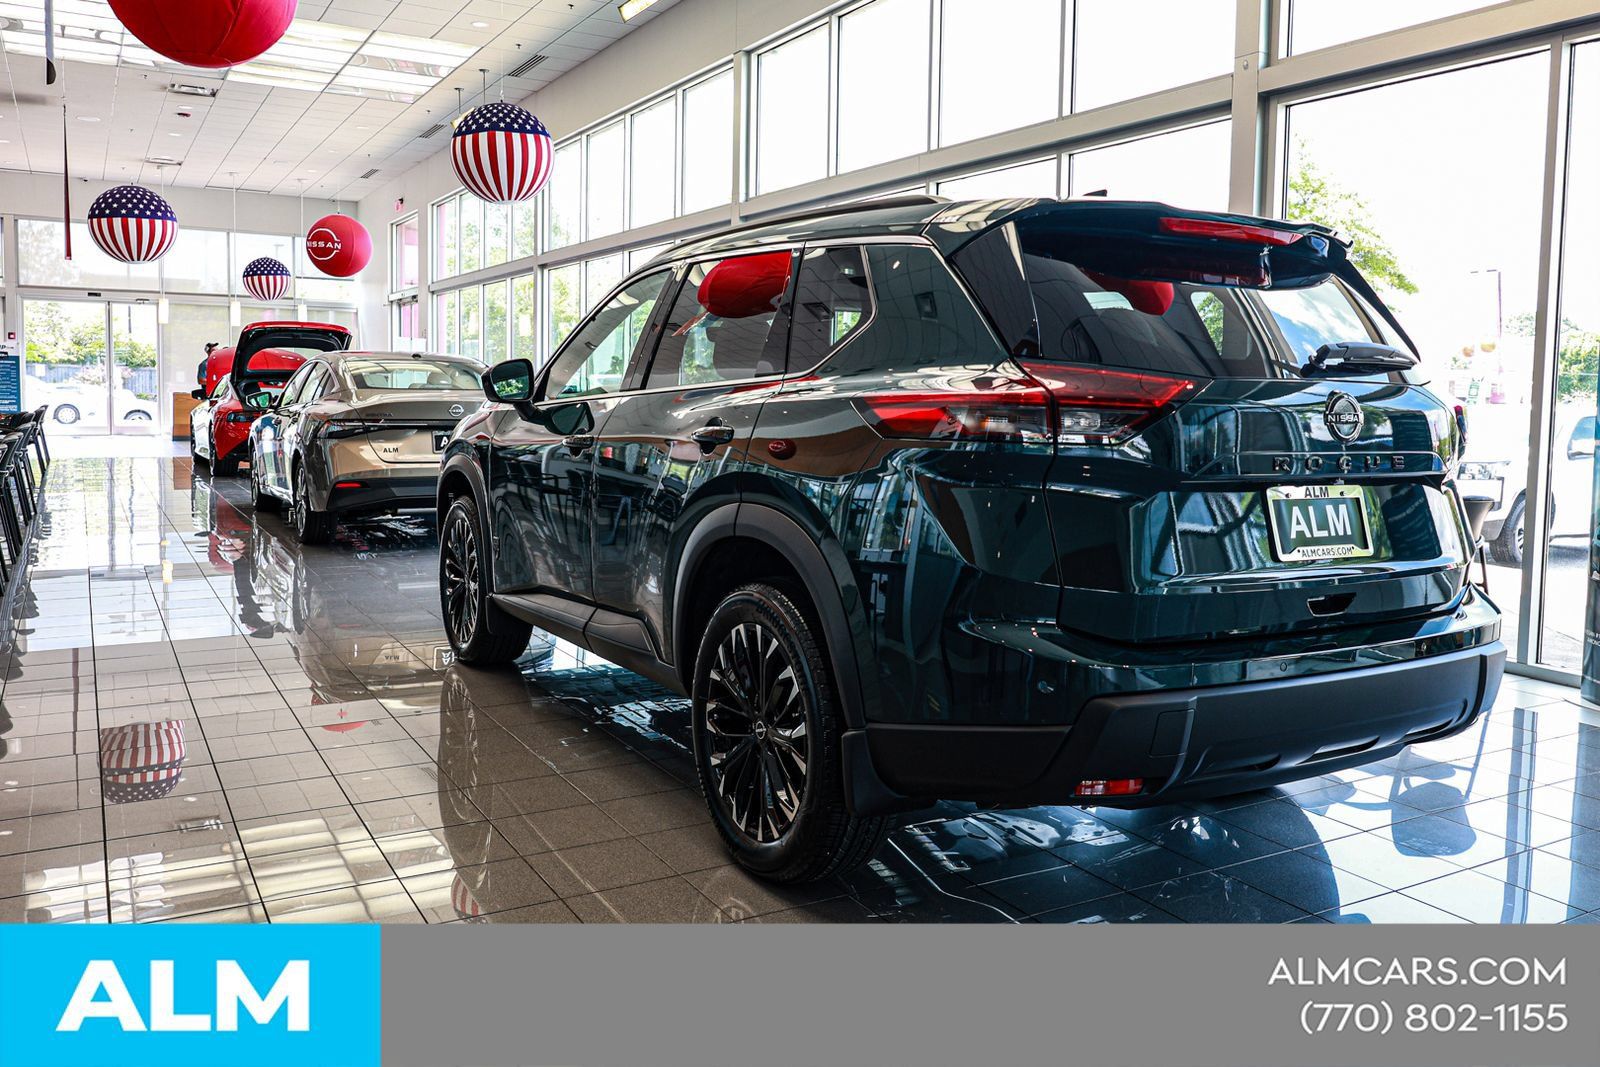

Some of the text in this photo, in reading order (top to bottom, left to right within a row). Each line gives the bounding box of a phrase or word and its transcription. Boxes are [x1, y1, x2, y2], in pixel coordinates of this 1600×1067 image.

[1327, 413, 1359, 423] NISSA
[1272, 455, 1406, 472] ROGUE
[1304, 486, 1330, 499] ALM
[1290, 503, 1352, 539] ALM
[1301, 547, 1354, 558] ALMCARS.COM
